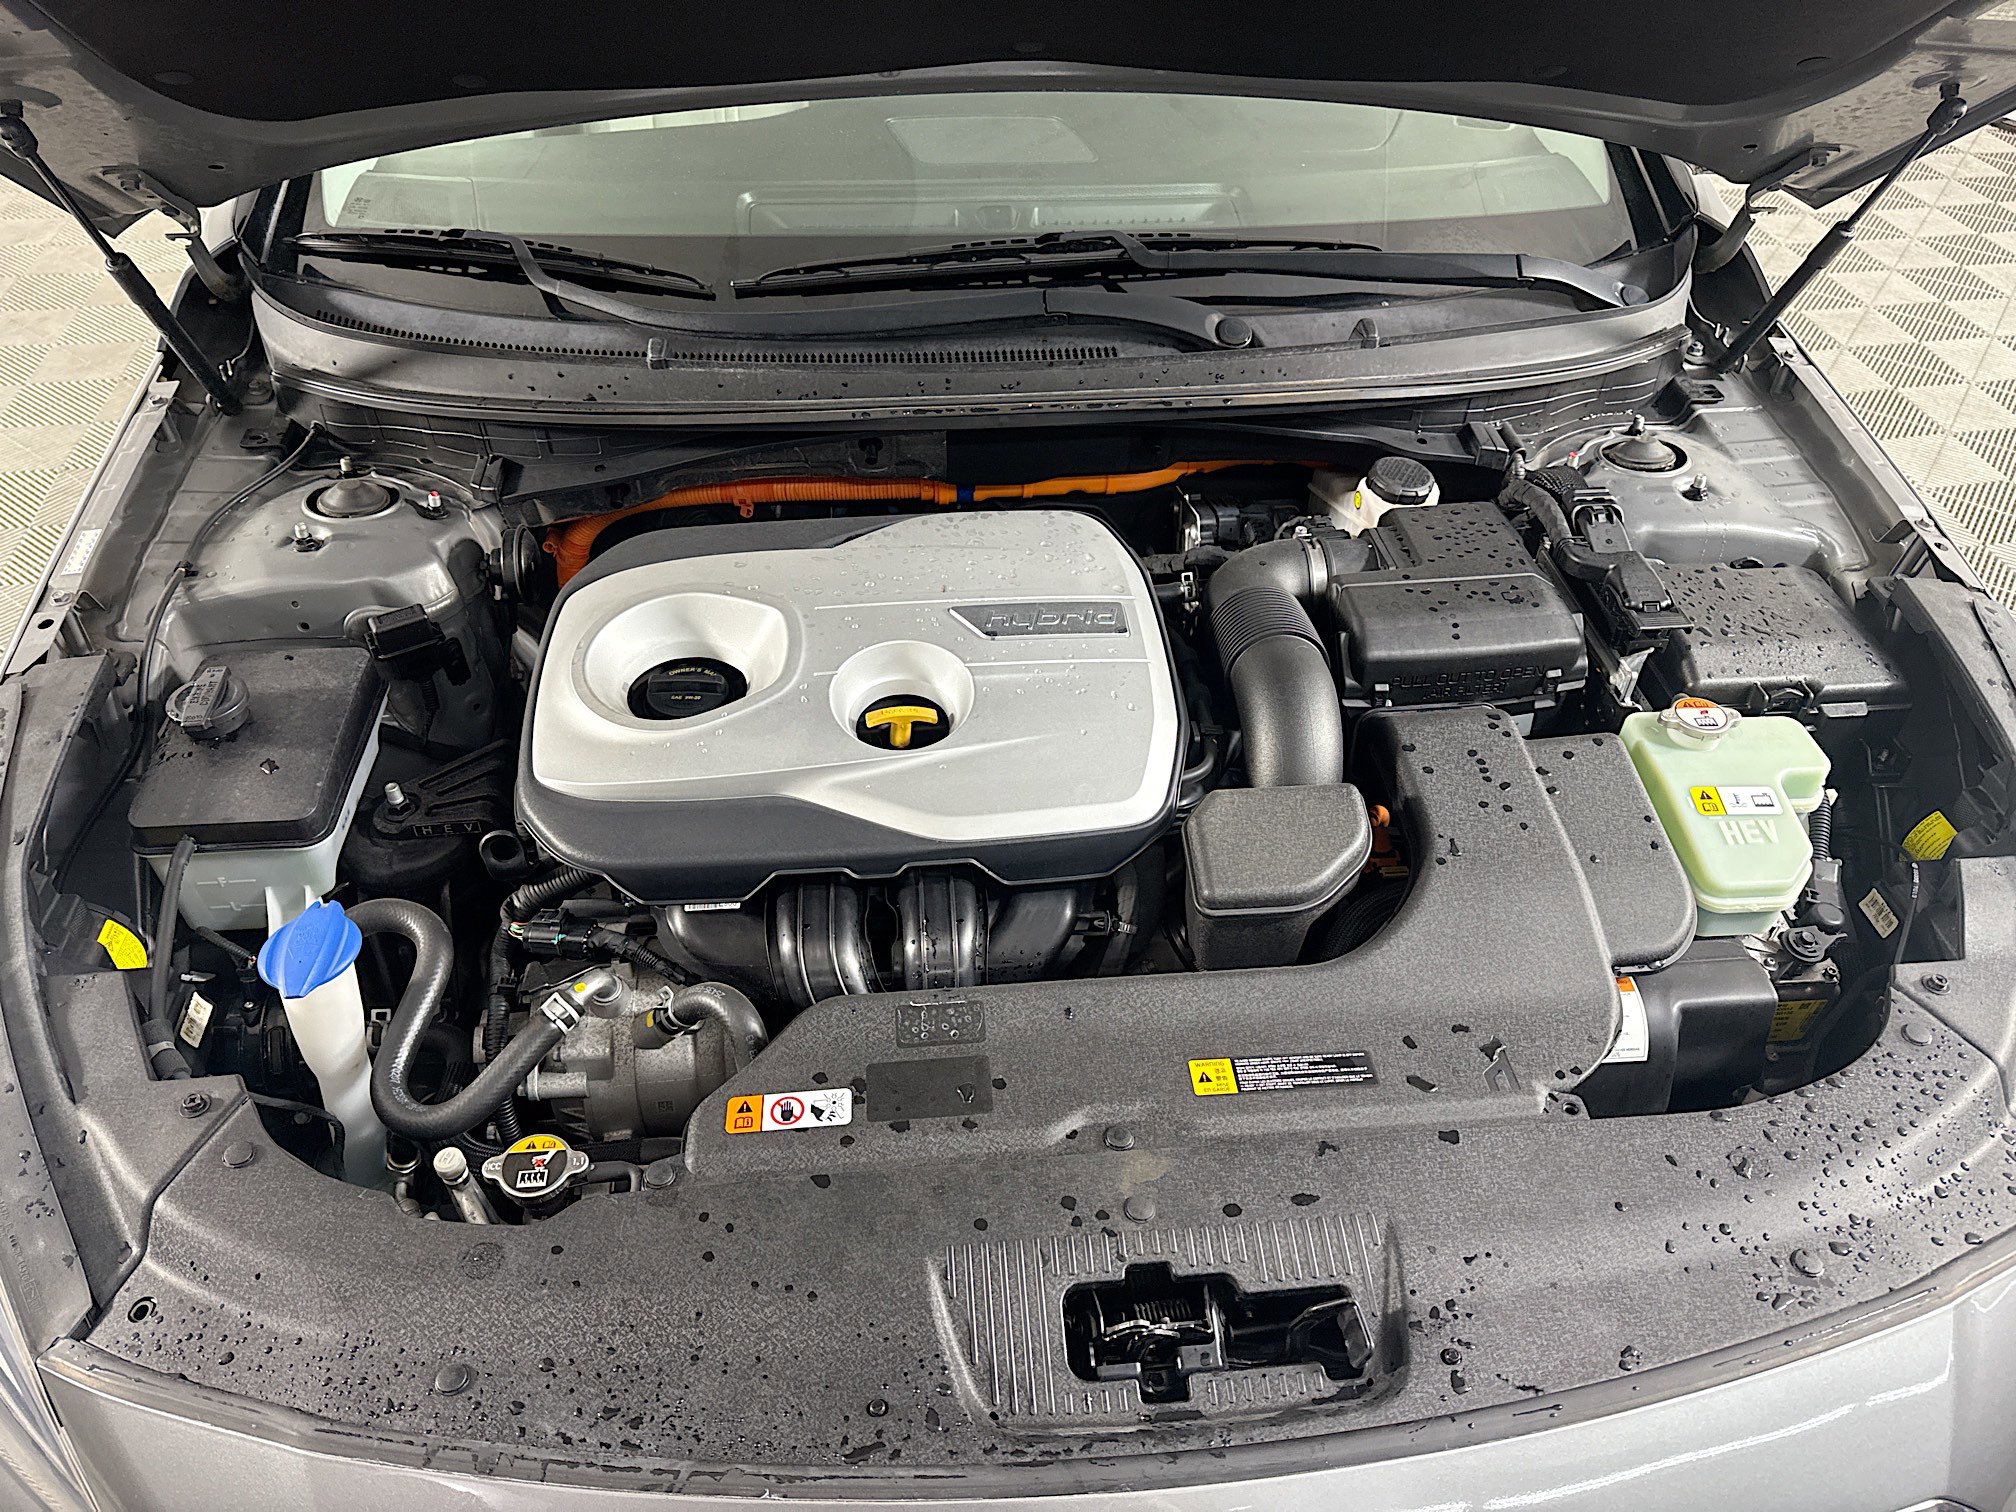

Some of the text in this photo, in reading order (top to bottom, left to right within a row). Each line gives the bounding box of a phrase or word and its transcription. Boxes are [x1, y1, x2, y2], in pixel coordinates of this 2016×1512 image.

[984, 608, 1118, 630] hybrid
[668, 667, 702, 676] OWNER'S
[1393, 666, 1545, 688] PULL OUT TO OPEN
[421, 823, 473, 835] HEV
[1718, 819, 1779, 846] HEV
